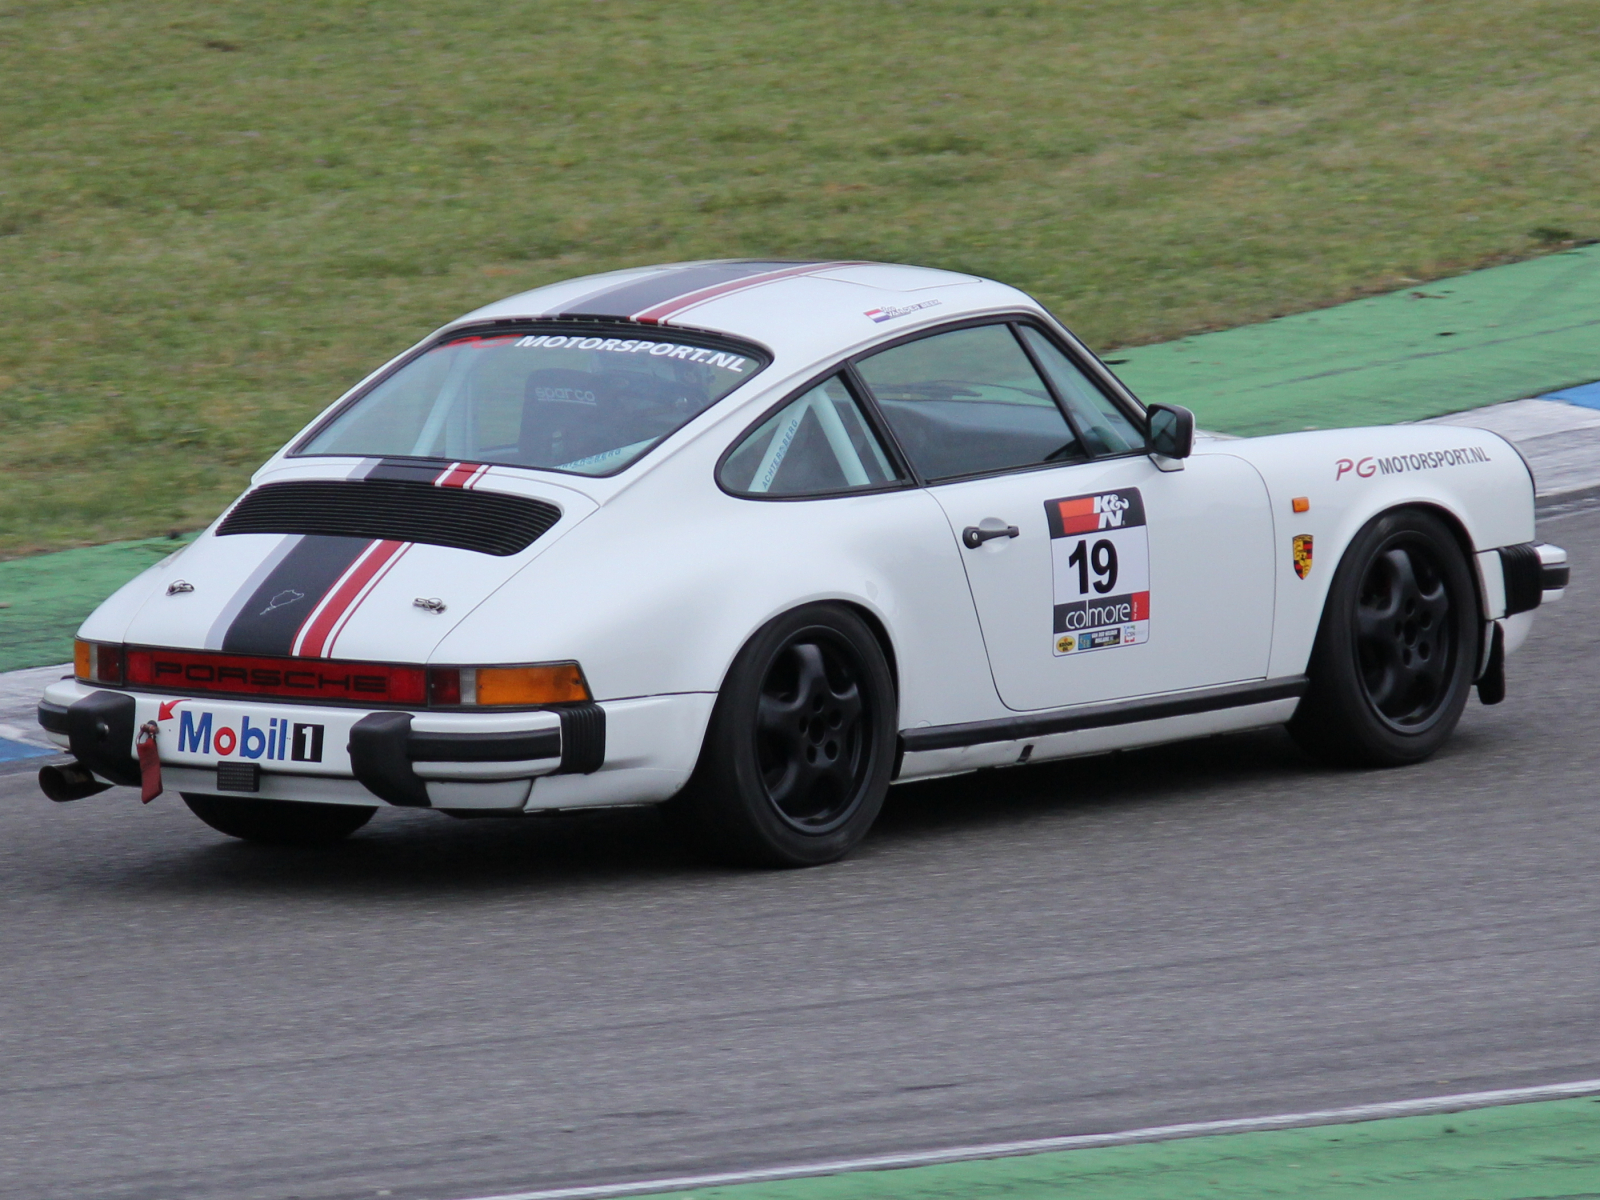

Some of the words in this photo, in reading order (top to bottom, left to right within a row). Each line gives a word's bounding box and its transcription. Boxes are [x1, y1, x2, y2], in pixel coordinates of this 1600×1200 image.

[515, 335, 746, 373] MOTORSPORT.NL
[535, 387, 597, 402] sparco
[1068, 539, 1118, 595] 19
[1066, 600, 1131, 629] colmore
[155, 660, 388, 693] PORSCHE
[178, 710, 288, 761] Mobil
